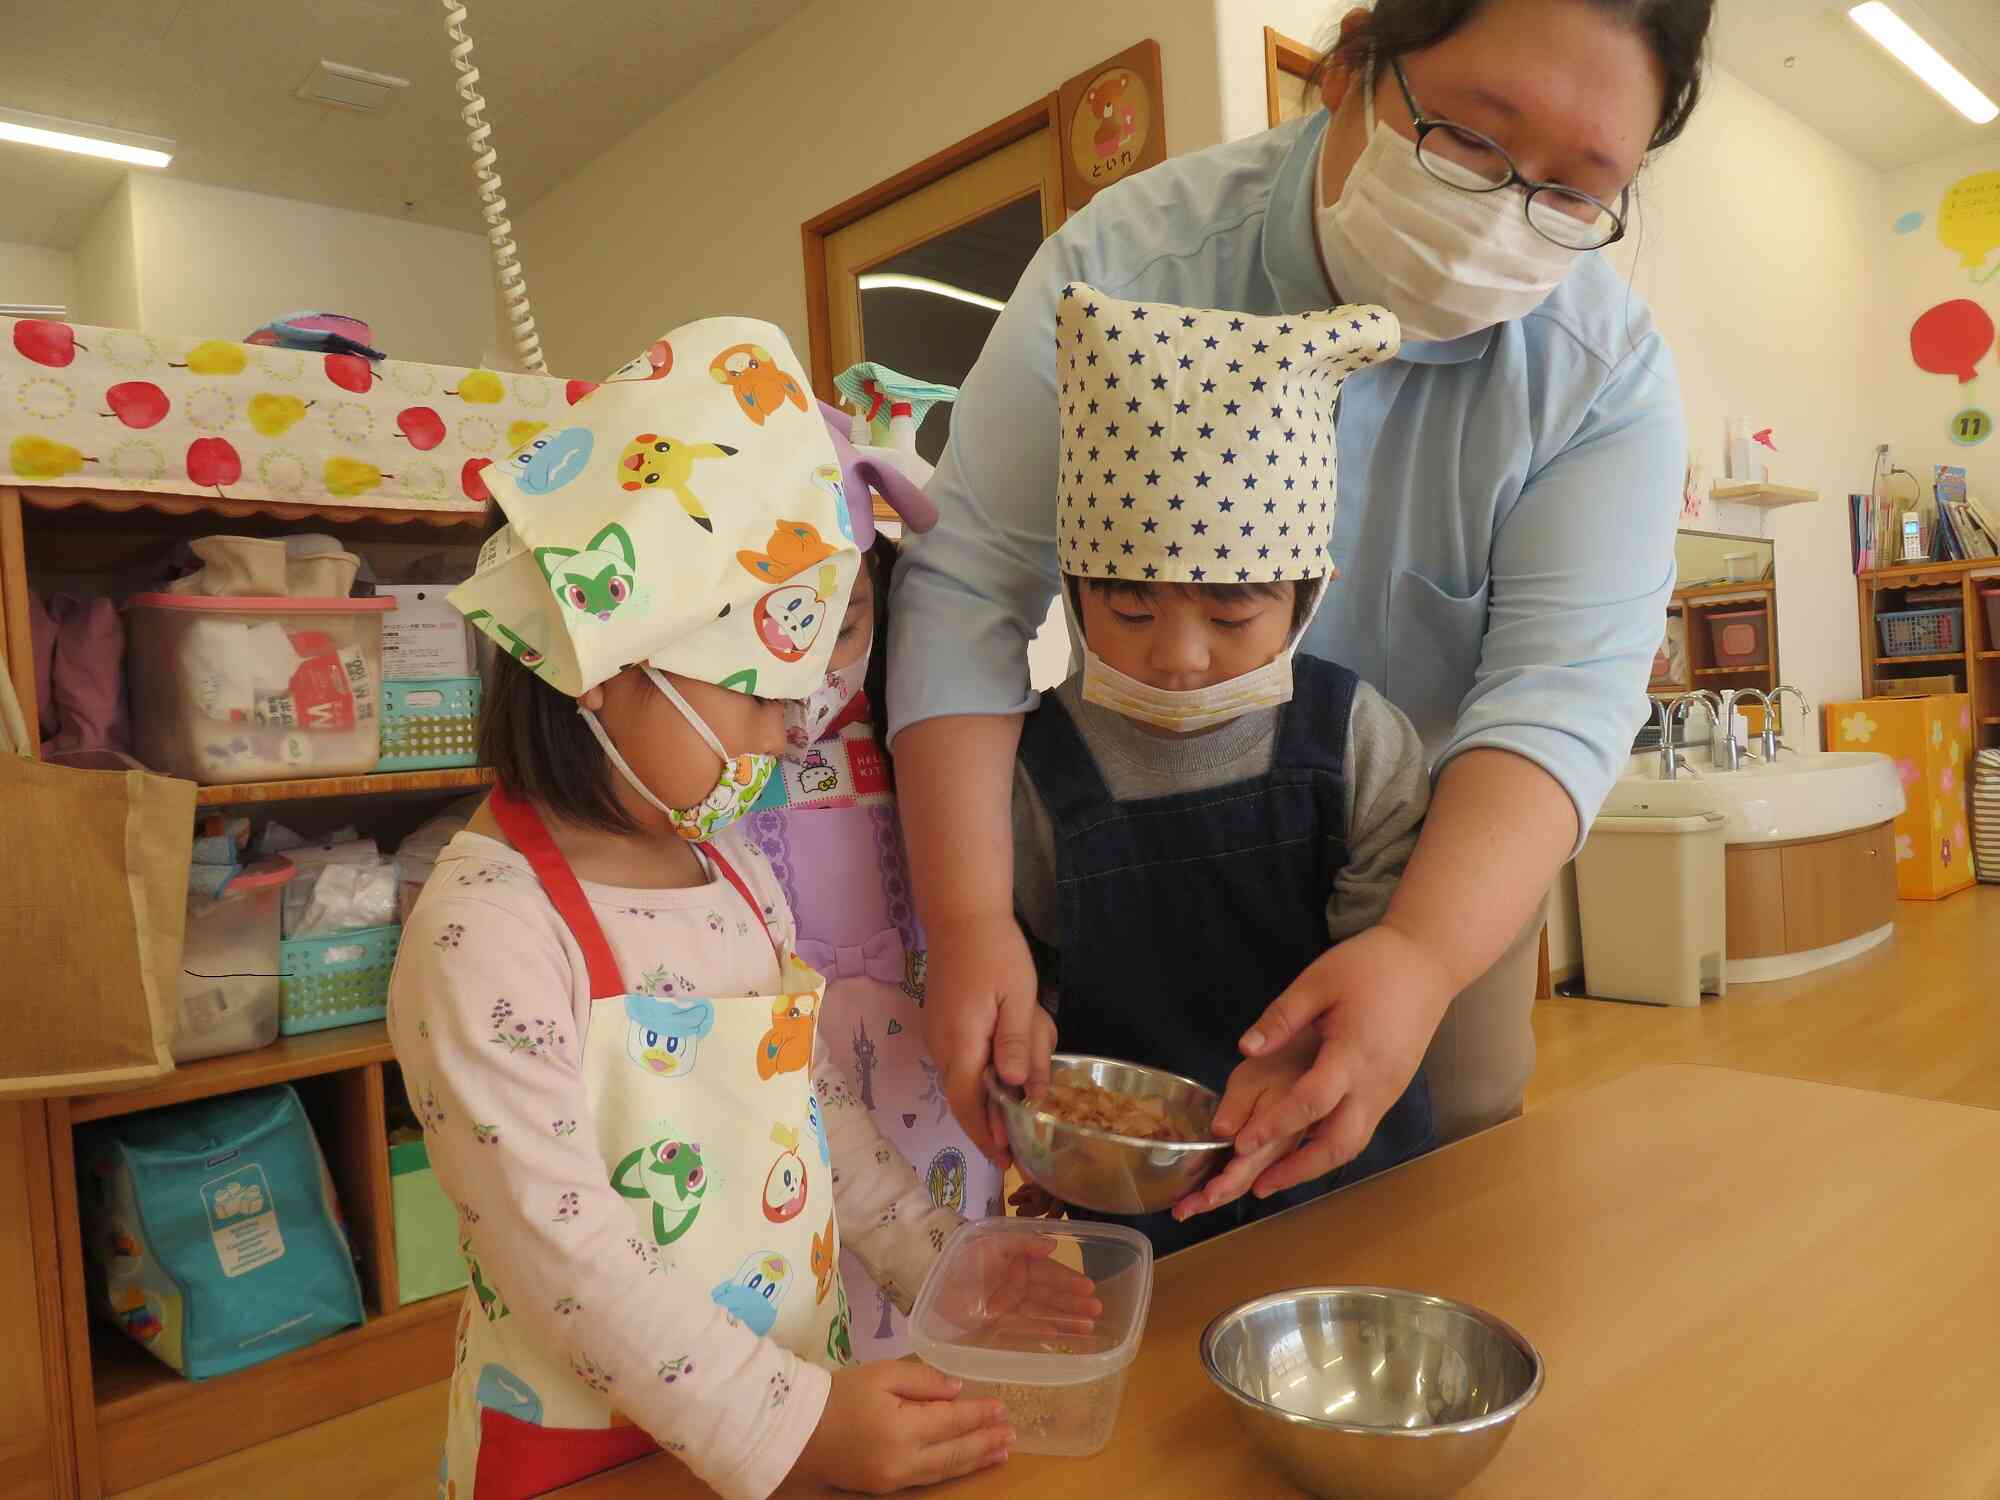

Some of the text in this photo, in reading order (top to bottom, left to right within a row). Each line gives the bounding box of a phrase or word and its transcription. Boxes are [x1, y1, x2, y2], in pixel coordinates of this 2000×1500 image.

[1092, 150, 1133, 178] といれ
[1960, 417, 1981, 436] 11
[857, 755, 880, 766] HEL
[860, 767, 881, 777] KIT
